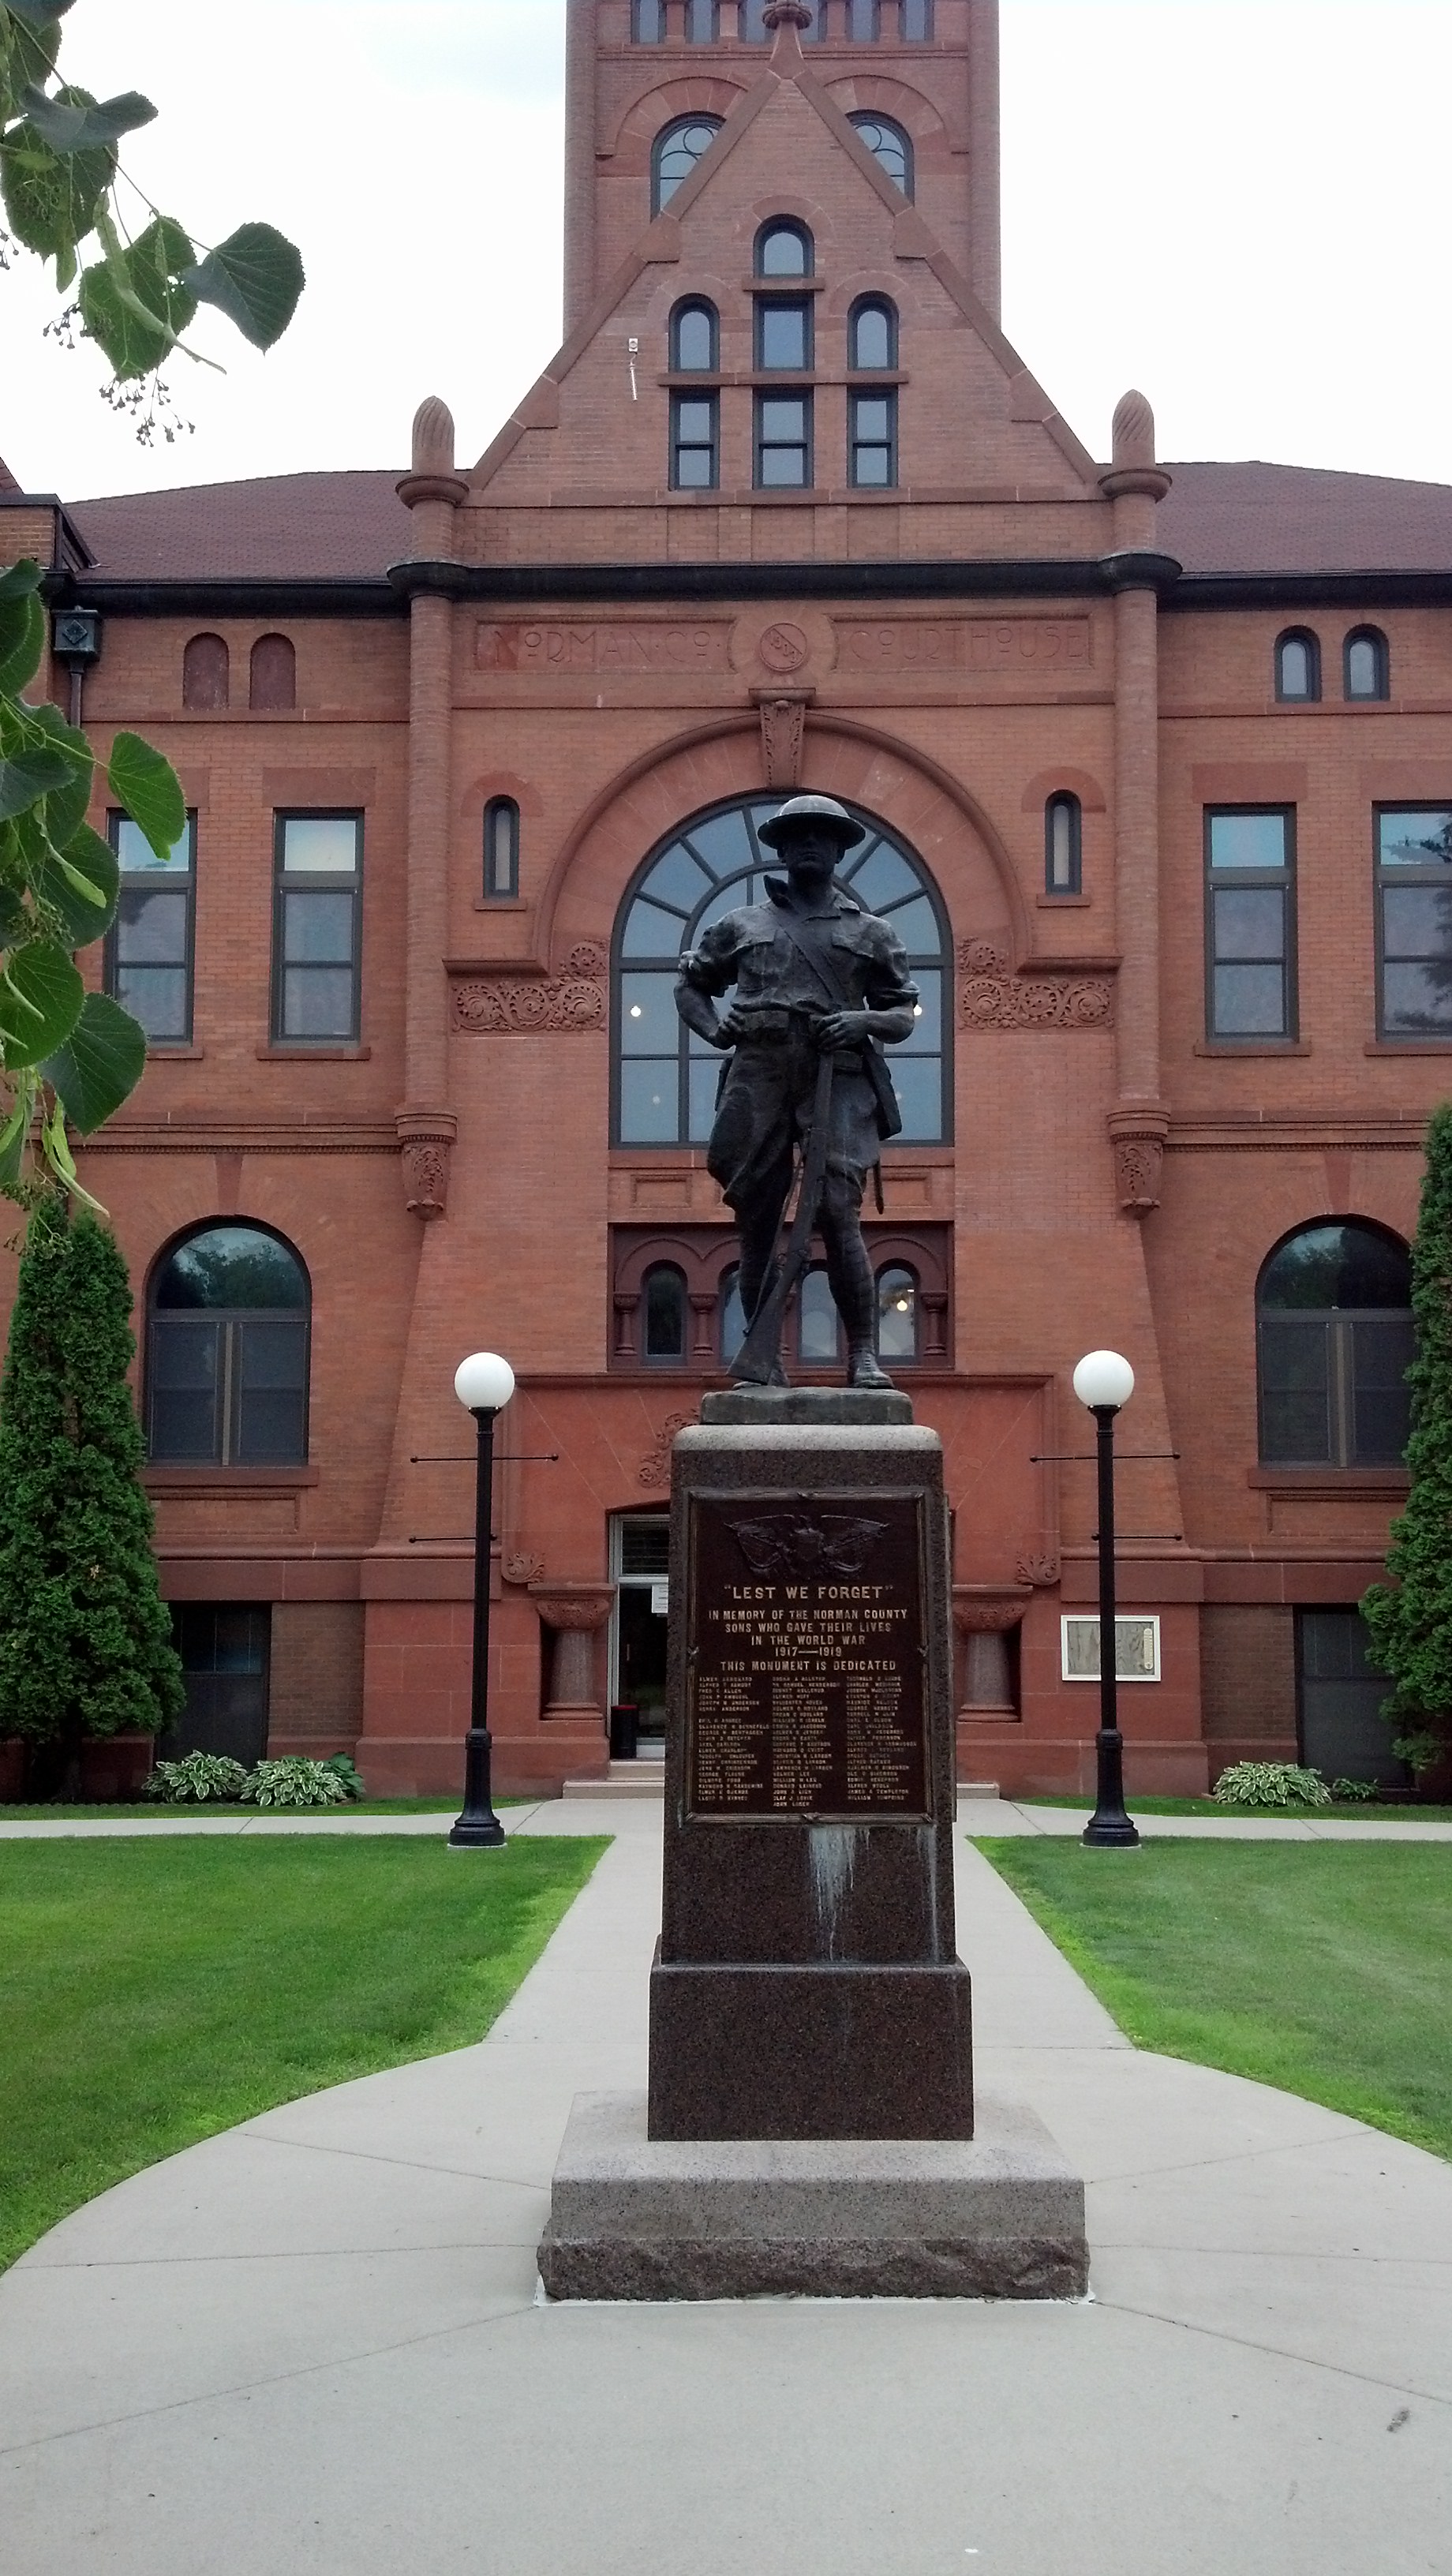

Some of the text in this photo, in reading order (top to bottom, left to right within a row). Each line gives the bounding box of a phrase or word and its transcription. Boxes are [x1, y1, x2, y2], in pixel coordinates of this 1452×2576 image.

[786, 1586, 808, 1599] WE
[709, 1609, 908, 1619] IN MEMORY OF THE NORMAN COUNTY
[725, 1623, 891, 1633] SONS WHO GAVE THEIR LIVES
[751, 1635, 865, 1646] IN THE WORLD WAR
[720, 1661, 896, 1672] THIS MONUMENT IS DEDICATED
